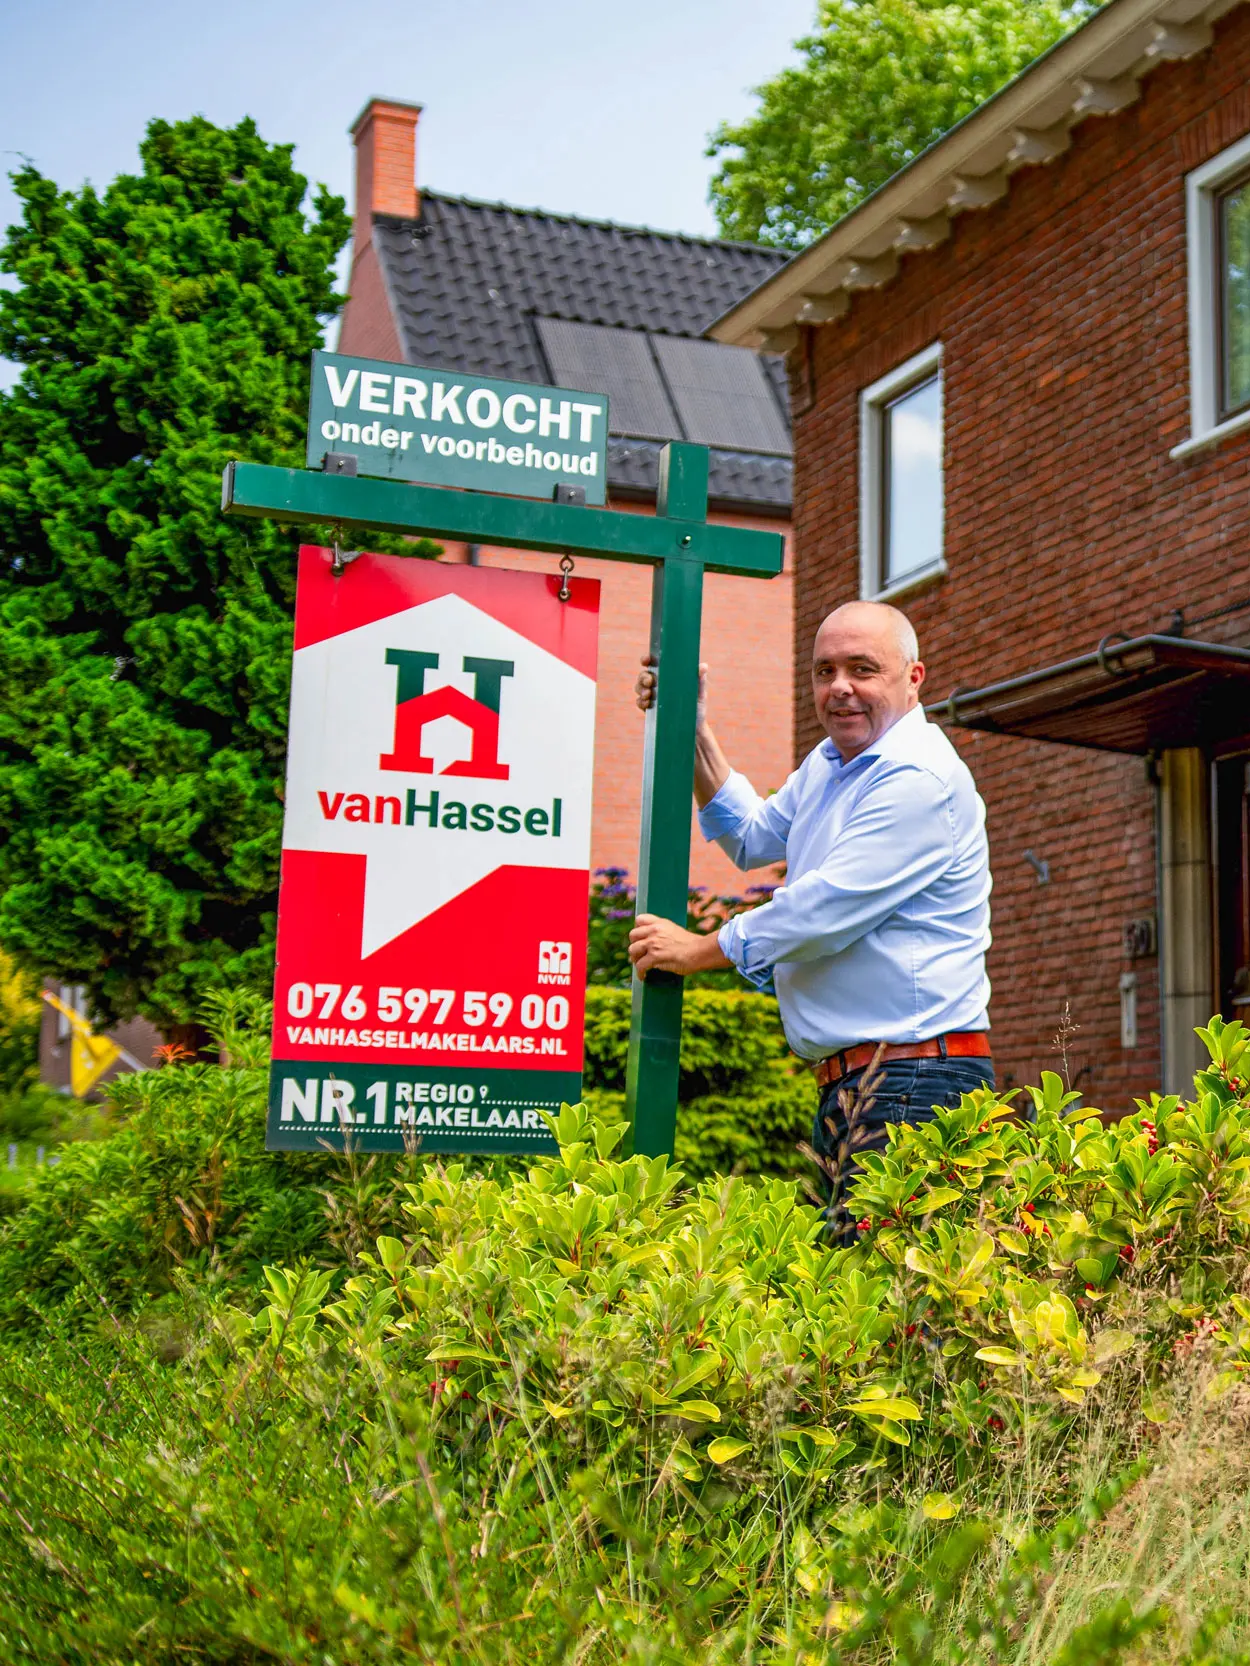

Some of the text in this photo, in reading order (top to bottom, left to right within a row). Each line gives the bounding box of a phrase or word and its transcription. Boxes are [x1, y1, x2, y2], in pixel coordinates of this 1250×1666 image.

[323, 366, 601, 442] VERKOCHT
[320, 420, 598, 476] onder voorbehoud
[318, 788, 563, 838] vanHassel
[537, 974, 571, 985] NVM
[287, 981, 570, 1030] 076 597 59 00
[286, 1026, 568, 1056] VANHASSELMAKELAARS.NL
[280, 1077, 388, 1125] NR.1
[394, 1081, 475, 1104] REGIO
